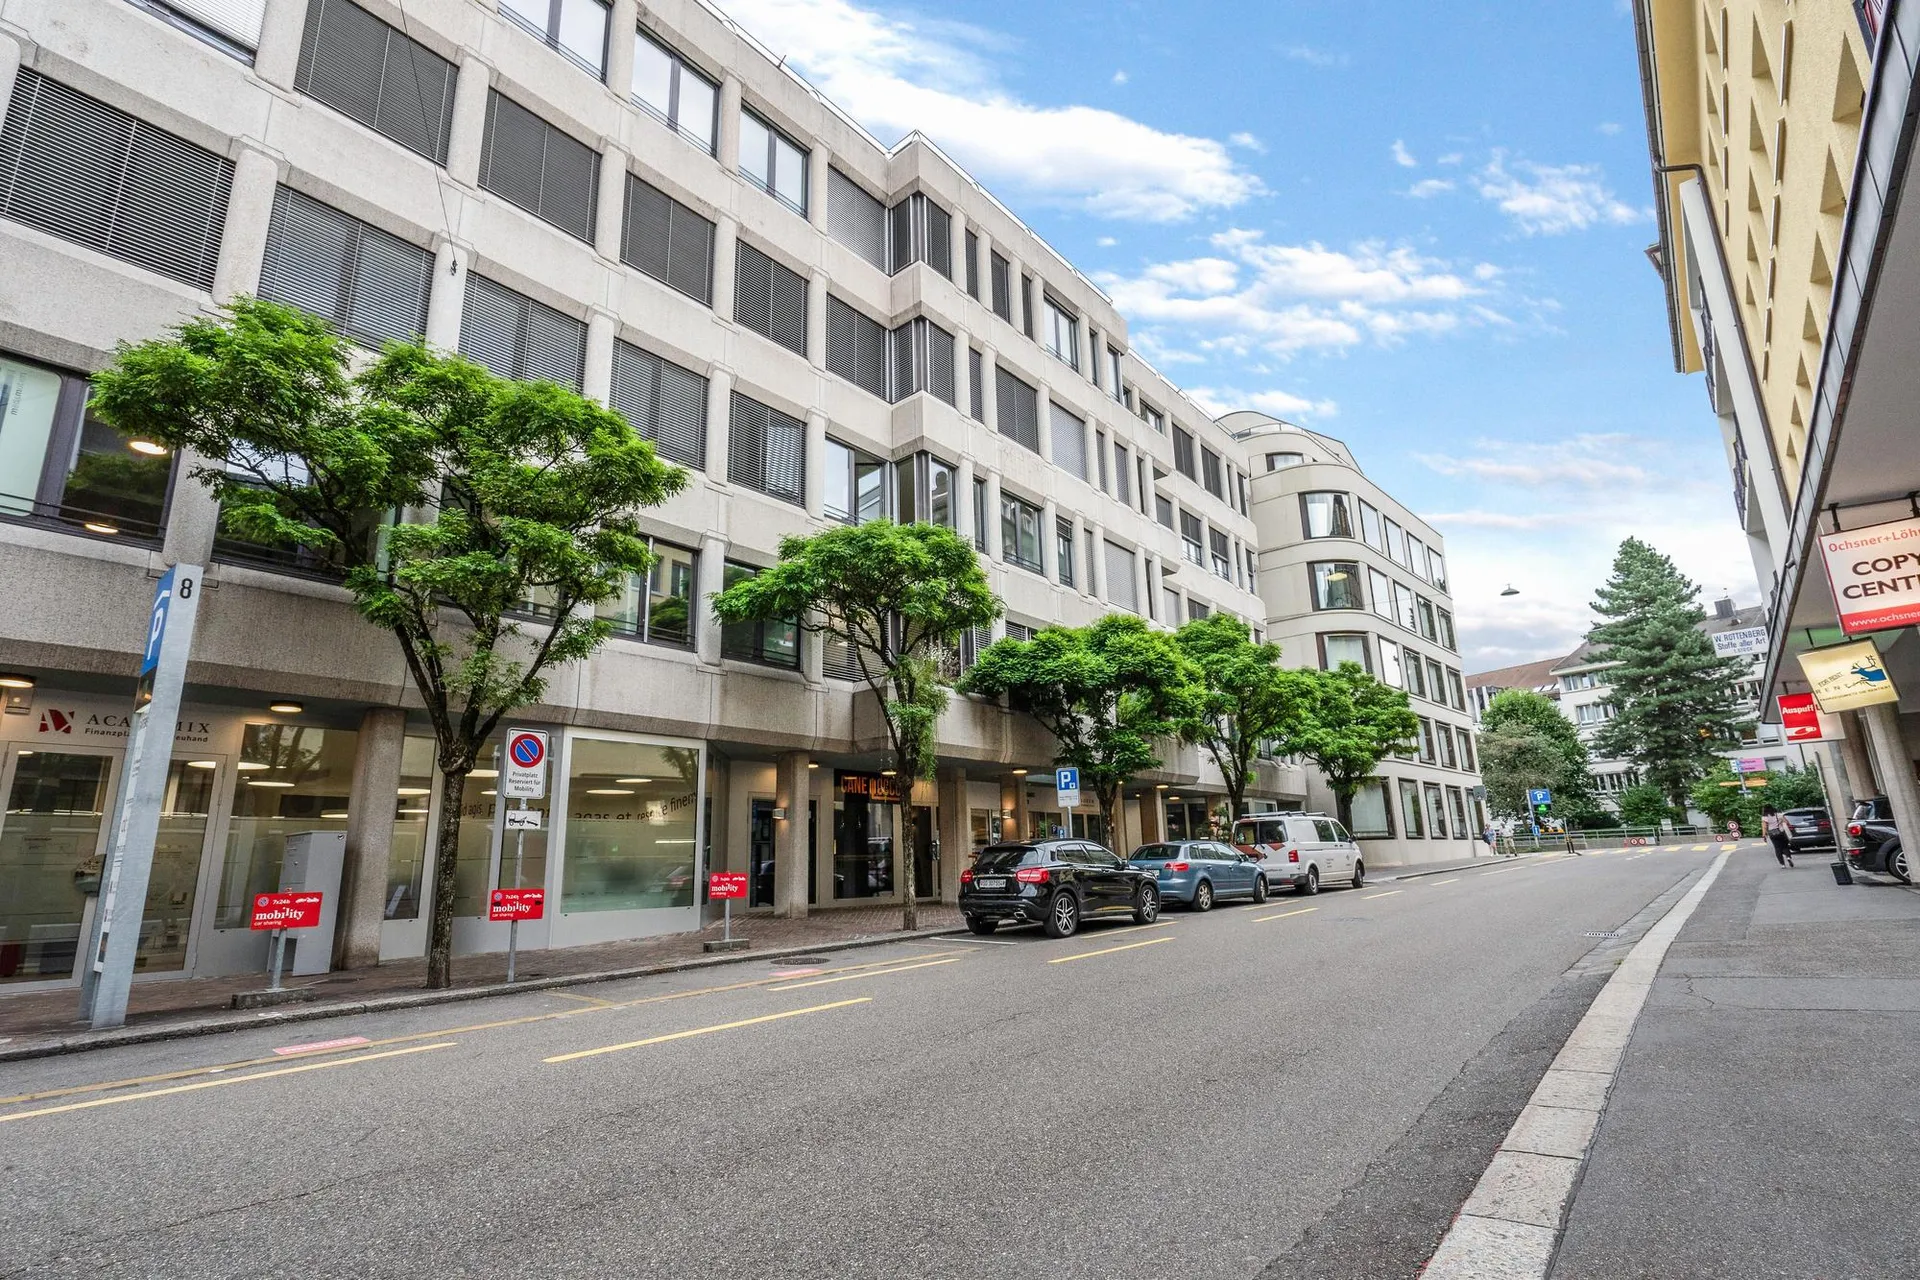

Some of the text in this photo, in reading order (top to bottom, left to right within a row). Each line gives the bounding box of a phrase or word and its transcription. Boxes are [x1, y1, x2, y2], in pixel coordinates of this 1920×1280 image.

[179, 578, 193, 599] 8
[1842, 573, 1920, 599] CENT
[1723, 629, 1766, 642] ROTTENBERG
[1717, 641, 1737, 651] Stoffe
[1755, 637, 1766, 645] Art
[1782, 703, 1815, 715] Auspuff
[841, 775, 868, 794] CANE
[1061, 772, 1071, 788] P
[514, 785, 534, 793] Mobility
[711, 882, 738, 892] mobility
[255, 907, 304, 920] mobility
[493, 901, 531, 913] mobility
